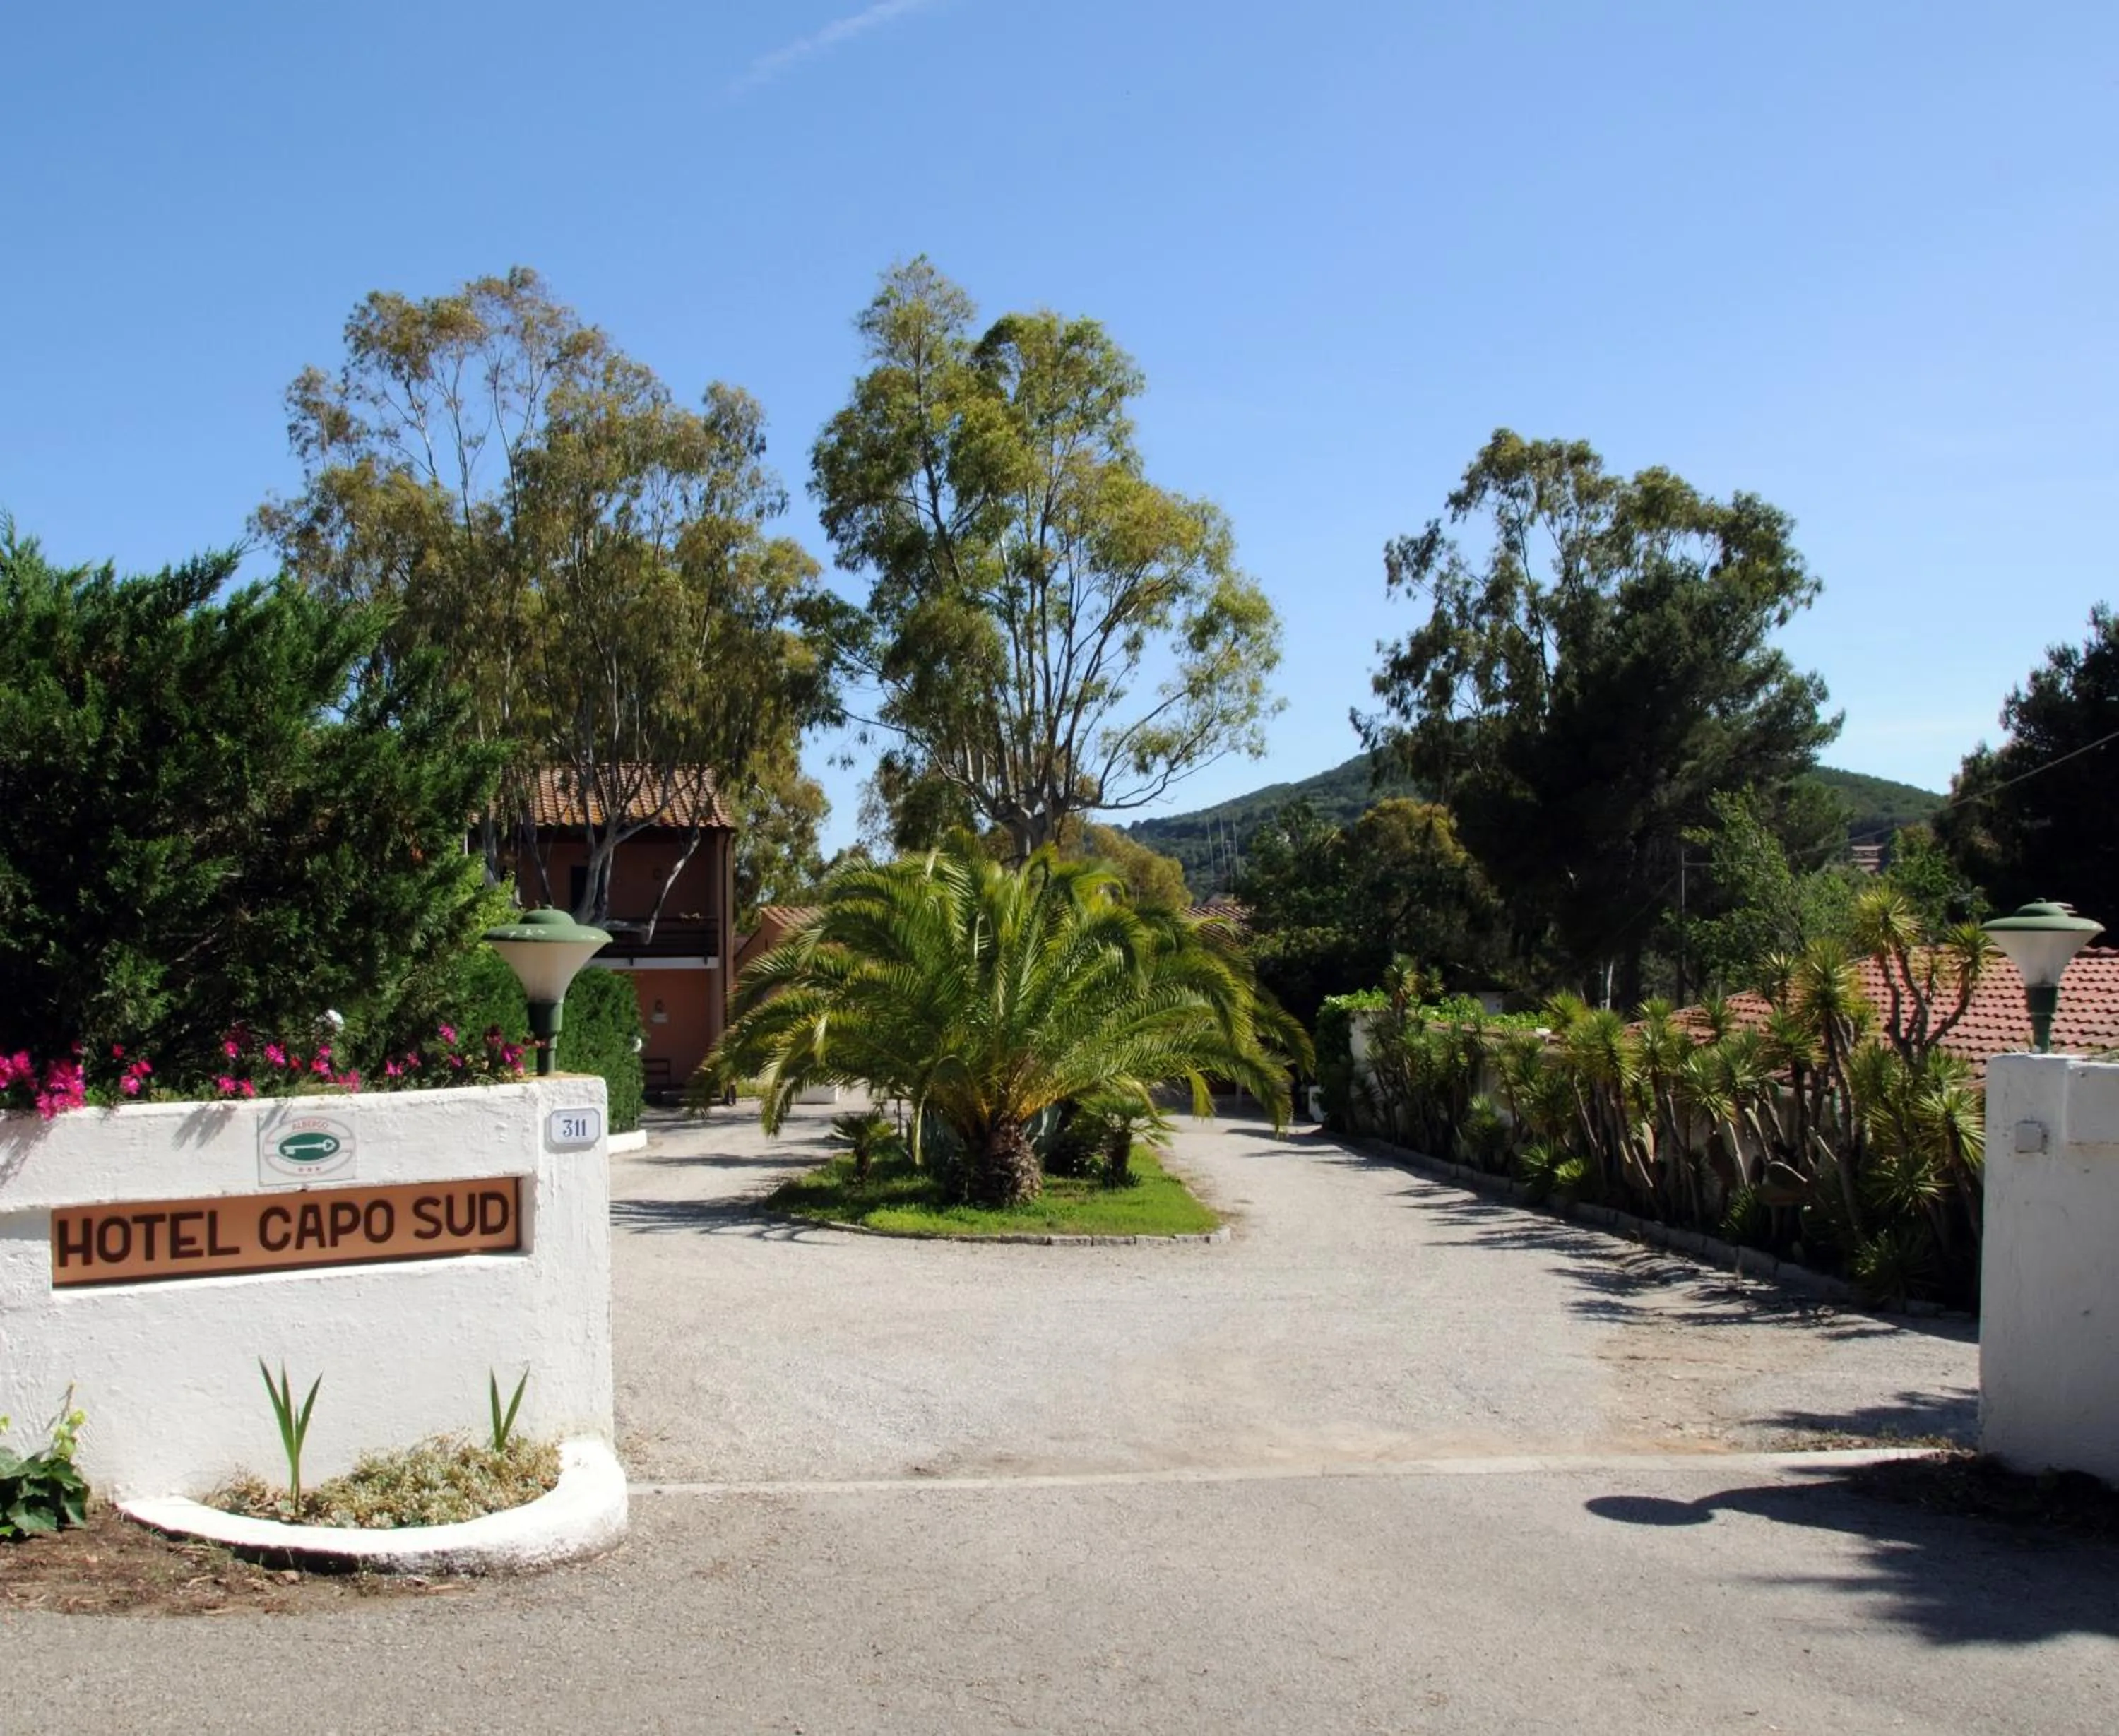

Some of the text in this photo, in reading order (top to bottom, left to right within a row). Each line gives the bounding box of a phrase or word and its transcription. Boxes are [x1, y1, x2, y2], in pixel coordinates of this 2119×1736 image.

[292, 1119, 328, 1130] ALBERGO
[563, 1119, 586, 1137] 311
[57, 1191, 510, 1268] HOTEL CAPO SUD
